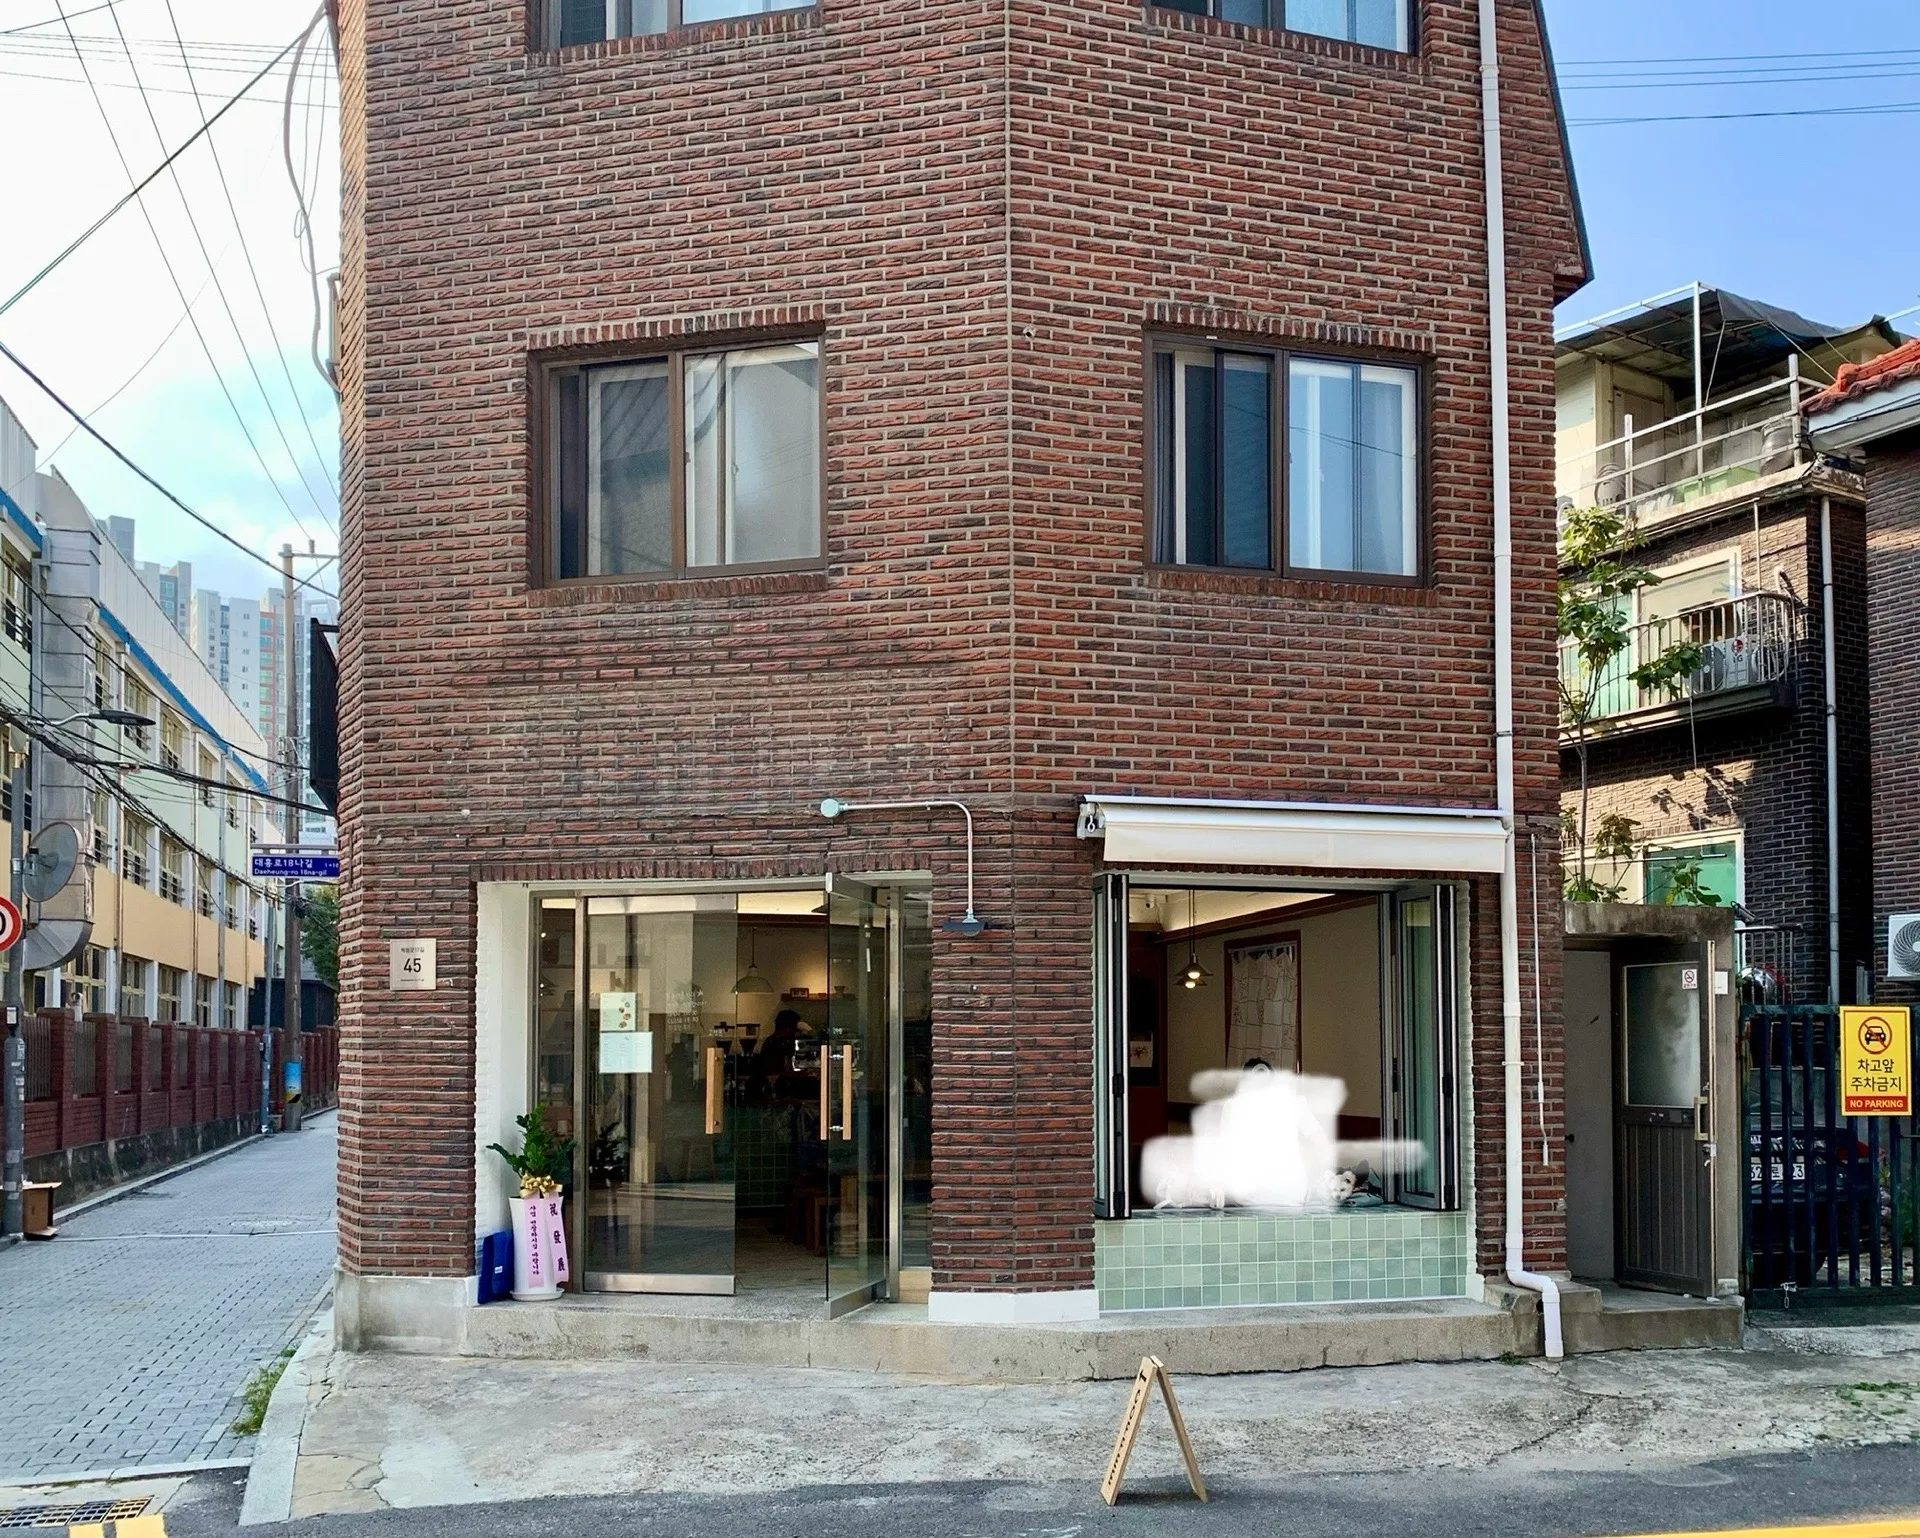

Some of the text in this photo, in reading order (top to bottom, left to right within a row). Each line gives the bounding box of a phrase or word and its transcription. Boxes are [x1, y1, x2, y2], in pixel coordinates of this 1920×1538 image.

[254, 858, 313, 869] 대흥로18나길
[403, 957, 422, 973] 45
[1857, 1058, 1895, 1074] 차고앞
[1850, 1076, 1902, 1092] 주차금지
[1849, 1099, 1904, 1108] NO PARKING
